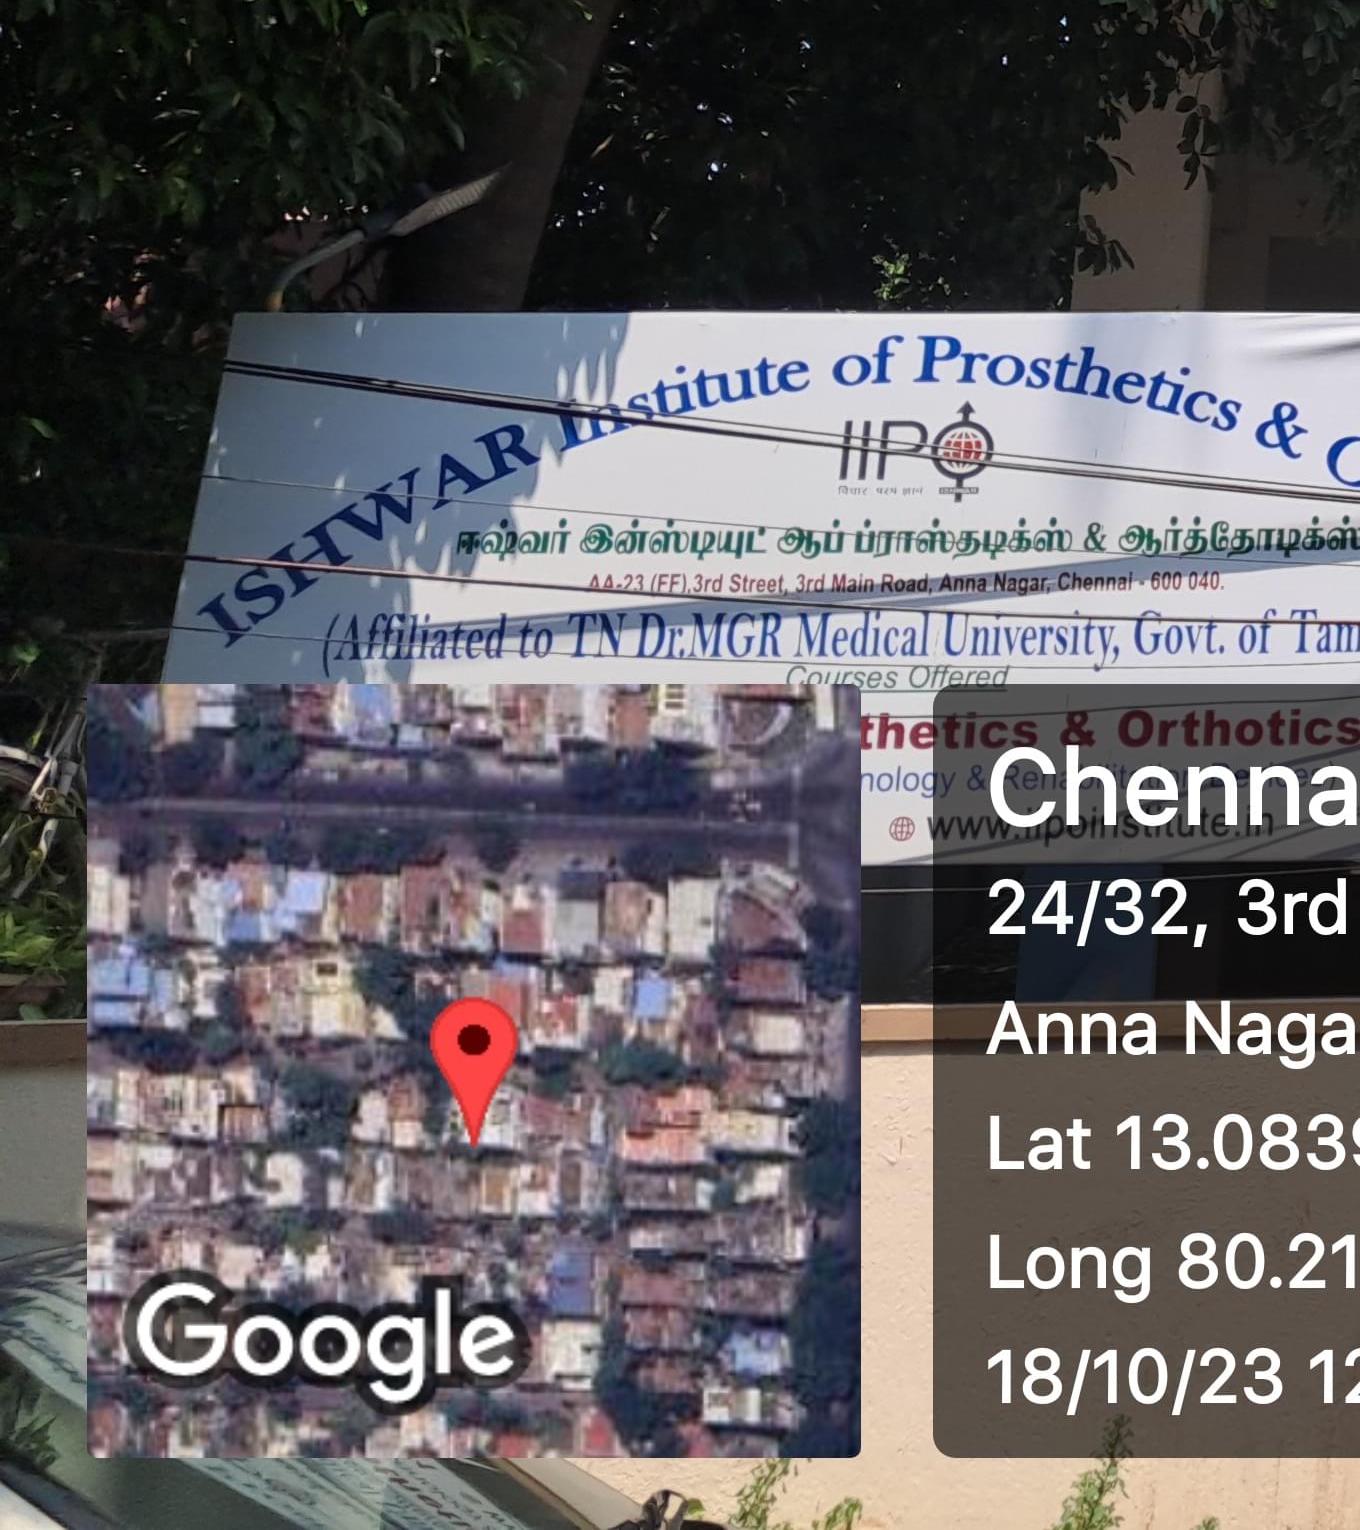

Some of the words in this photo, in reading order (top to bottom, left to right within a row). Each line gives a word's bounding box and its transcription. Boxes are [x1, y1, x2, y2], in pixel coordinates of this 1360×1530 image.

[197, 423, 540, 648] ISHWAR
[556, 356, 810, 452] Institute
[832, 335, 904, 387] of
[913, 334, 1243, 433] Prosthetics
[1254, 401, 1309, 459] &
[1084, 522, 1107, 553] &
[729, 573, 788, 596] Street,
[796, 573, 823, 592] 3rd
[832, 573, 874, 592] Main
[881, 573, 932, 595] Road,
[939, 573, 986, 592] Anna
[994, 573, 1051, 595] Nagar,
[1058, 571, 1132, 591] Chennai
[1151, 571, 1181, 590] 600
[1189, 571, 1225, 590] 040.
[321, 613, 503, 677] (Affiliated
[518, 619, 552, 659] to
[567, 614, 620, 658] TN
[795, 611, 930, 658] Medical
[944, 611, 1120, 666] University,
[1134, 611, 1226, 657] Govt.
[1238, 609, 1276, 654] of
[786, 666, 898, 689] Courses
[909, 663, 1009, 689] Offered
[861, 712, 1038, 750] thetics
[1060, 710, 1095, 747] &
[967, 764, 986, 791] &
